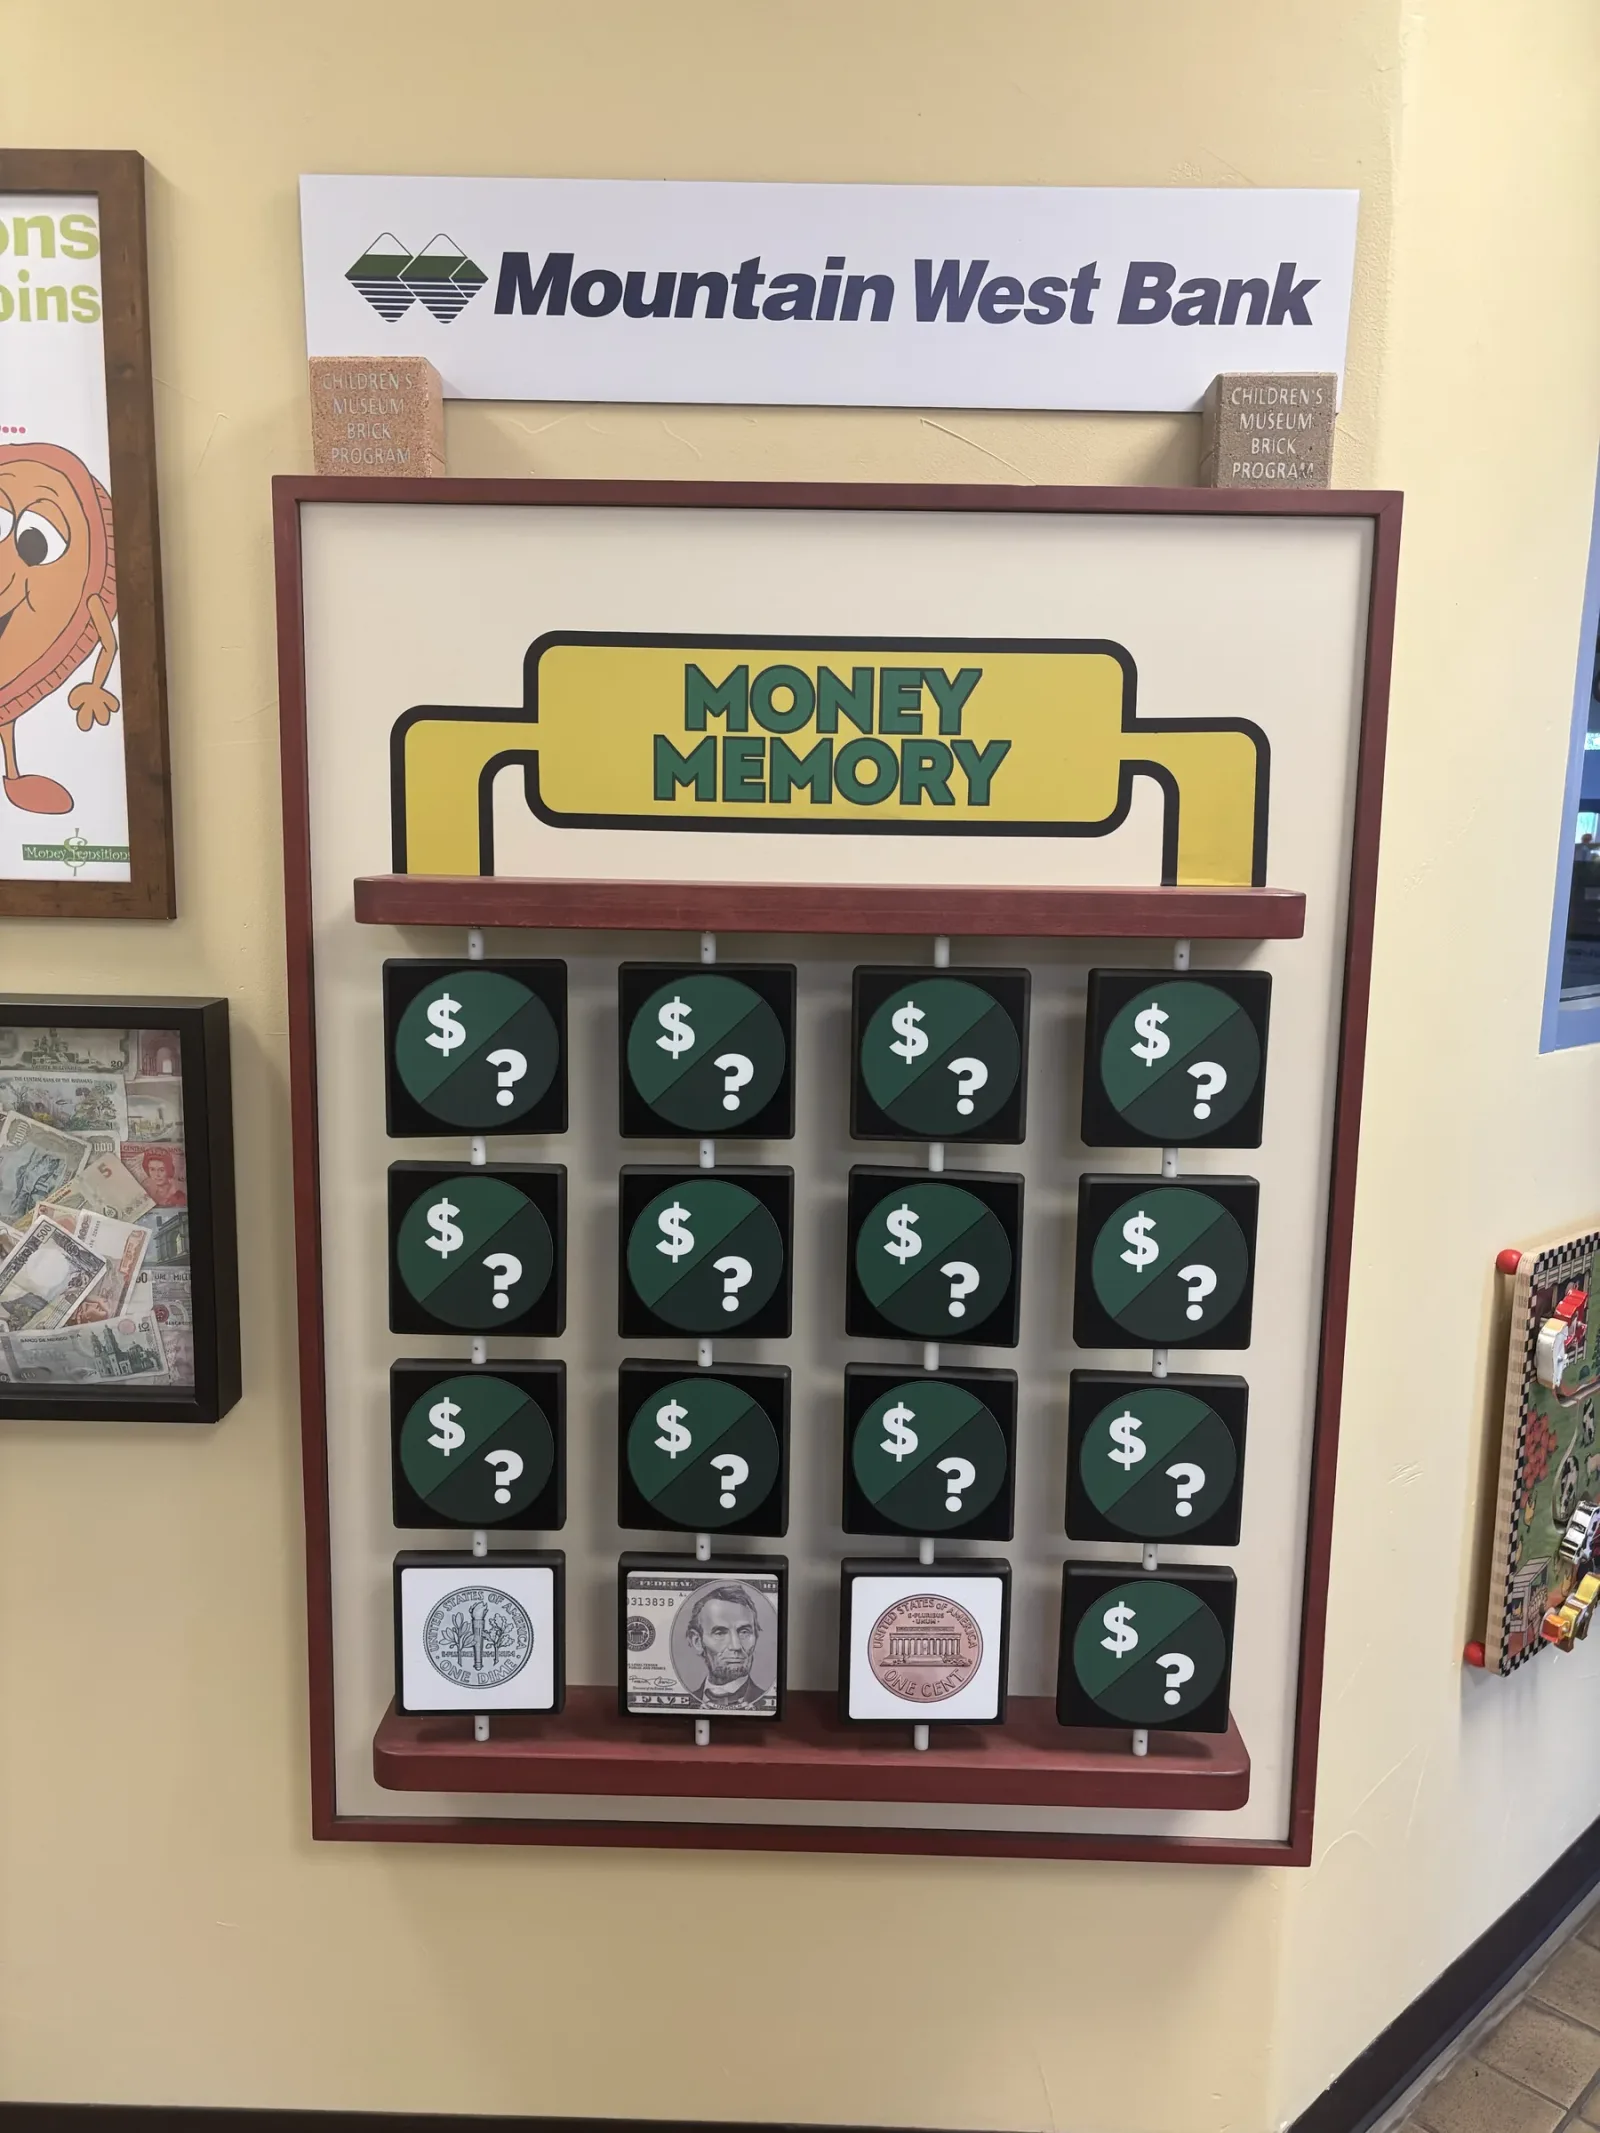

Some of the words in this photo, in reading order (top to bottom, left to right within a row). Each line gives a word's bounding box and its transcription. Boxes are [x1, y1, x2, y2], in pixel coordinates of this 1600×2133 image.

[0, 213, 100, 260] ns
[494, 252, 895, 322] Mountain
[914, 259, 1102, 326] West
[1117, 261, 1322, 326] Bank
[322, 372, 414, 391] CHILDRENS
[333, 397, 405, 415] MUSEUM
[1231, 387, 1323, 405] CHILDREN'S
[347, 422, 393, 440] BRICK
[1240, 412, 1313, 430] MUSEUM
[1251, 437, 1297, 455] BRICK
[331, 447, 411, 465] PROGRAM
[1233, 461, 1314, 479] PROGRAM
[684, 663, 983, 736] MONEY
[653, 733, 1013, 807] MEMORY
[26, 846, 67, 860] Money
[425, 993, 466, 1056] $
[656, 996, 695, 1059] $
[890, 1001, 928, 1064] $
[1130, 1003, 1170, 1067] $
[110, 1060, 123, 1068] 20
[486, 1049, 527, 1106] ?
[714, 1054, 753, 1110] ?
[948, 1058, 987, 1114] ?
[1187, 1062, 1227, 1119] ?
[97, 1162, 112, 1179] 5
[36, 1224, 52, 1241] 500
[425, 1198, 463, 1258] $
[656, 1202, 694, 1263] $
[884, 1204, 922, 1264] $
[1120, 1211, 1159, 1272] $
[483, 1253, 522, 1308] ?
[713, 1256, 752, 1311] ?
[940, 1262, 979, 1317] ?
[1178, 1265, 1216, 1320] ?
[428, 1397, 465, 1456] $
[655, 1400, 691, 1458] $
[880, 1402, 918, 1462] $
[1108, 1411, 1146, 1470] $
[485, 1450, 523, 1503] ?
[710, 1454, 748, 1508] ?
[937, 1458, 975, 1512] ?
[1166, 1463, 1205, 1517] ?
[639, 1579, 693, 1588] FEDERAL
[427, 1610, 444, 1653] UNITED
[443, 1591, 484, 1611] STATES
[488, 1593, 504, 1604] OF
[502, 1601, 528, 1650] AMERICA
[873, 1611, 897, 1649] UNITED
[897, 1599, 935, 1615] STATES
[936, 1602, 949, 1611] OF
[946, 1607, 978, 1649] AMERICA
[1101, 1601, 1138, 1658] $
[440, 1659, 472, 1684] ONE
[477, 1659, 517, 1685] DIME
[884, 1669, 917, 1696] ONE
[921, 1668, 965, 1698] CENT
[1156, 1653, 1194, 1705] ?
[634, 1696, 691, 1705] FIVE
